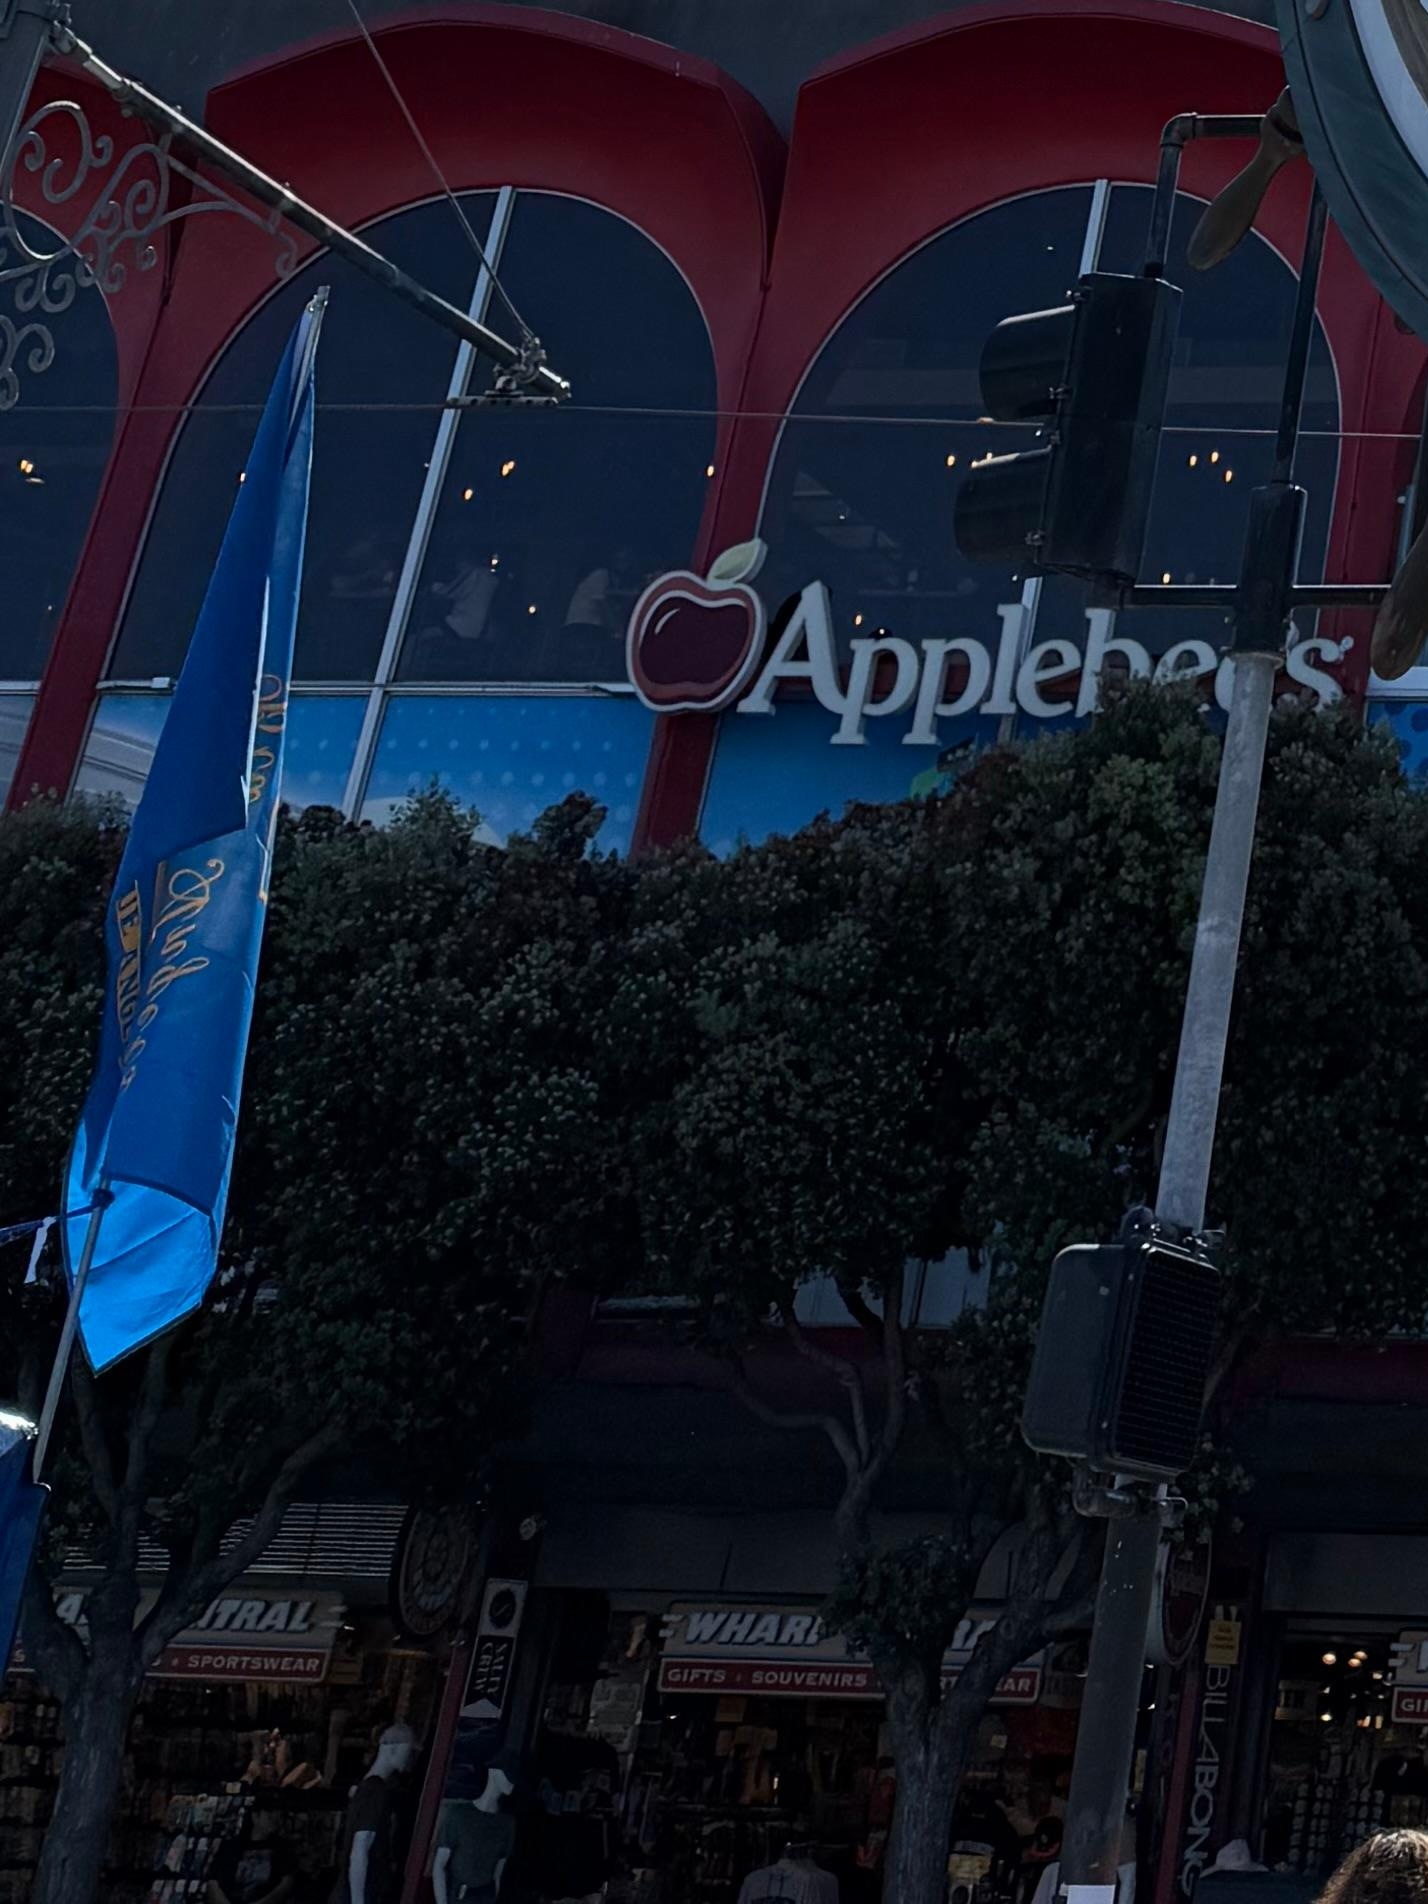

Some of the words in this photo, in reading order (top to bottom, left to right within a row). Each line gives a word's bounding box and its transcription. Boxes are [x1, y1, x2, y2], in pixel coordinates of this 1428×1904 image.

[198, 1599, 316, 1633] TRAL
[187, 1654, 320, 1672] SPORTSWEAR
[667, 1668, 727, 1683] GIFTS
[751, 1670, 868, 1688] SOUVENIRS
[1181, 1664, 1231, 1896] BILLABONG
